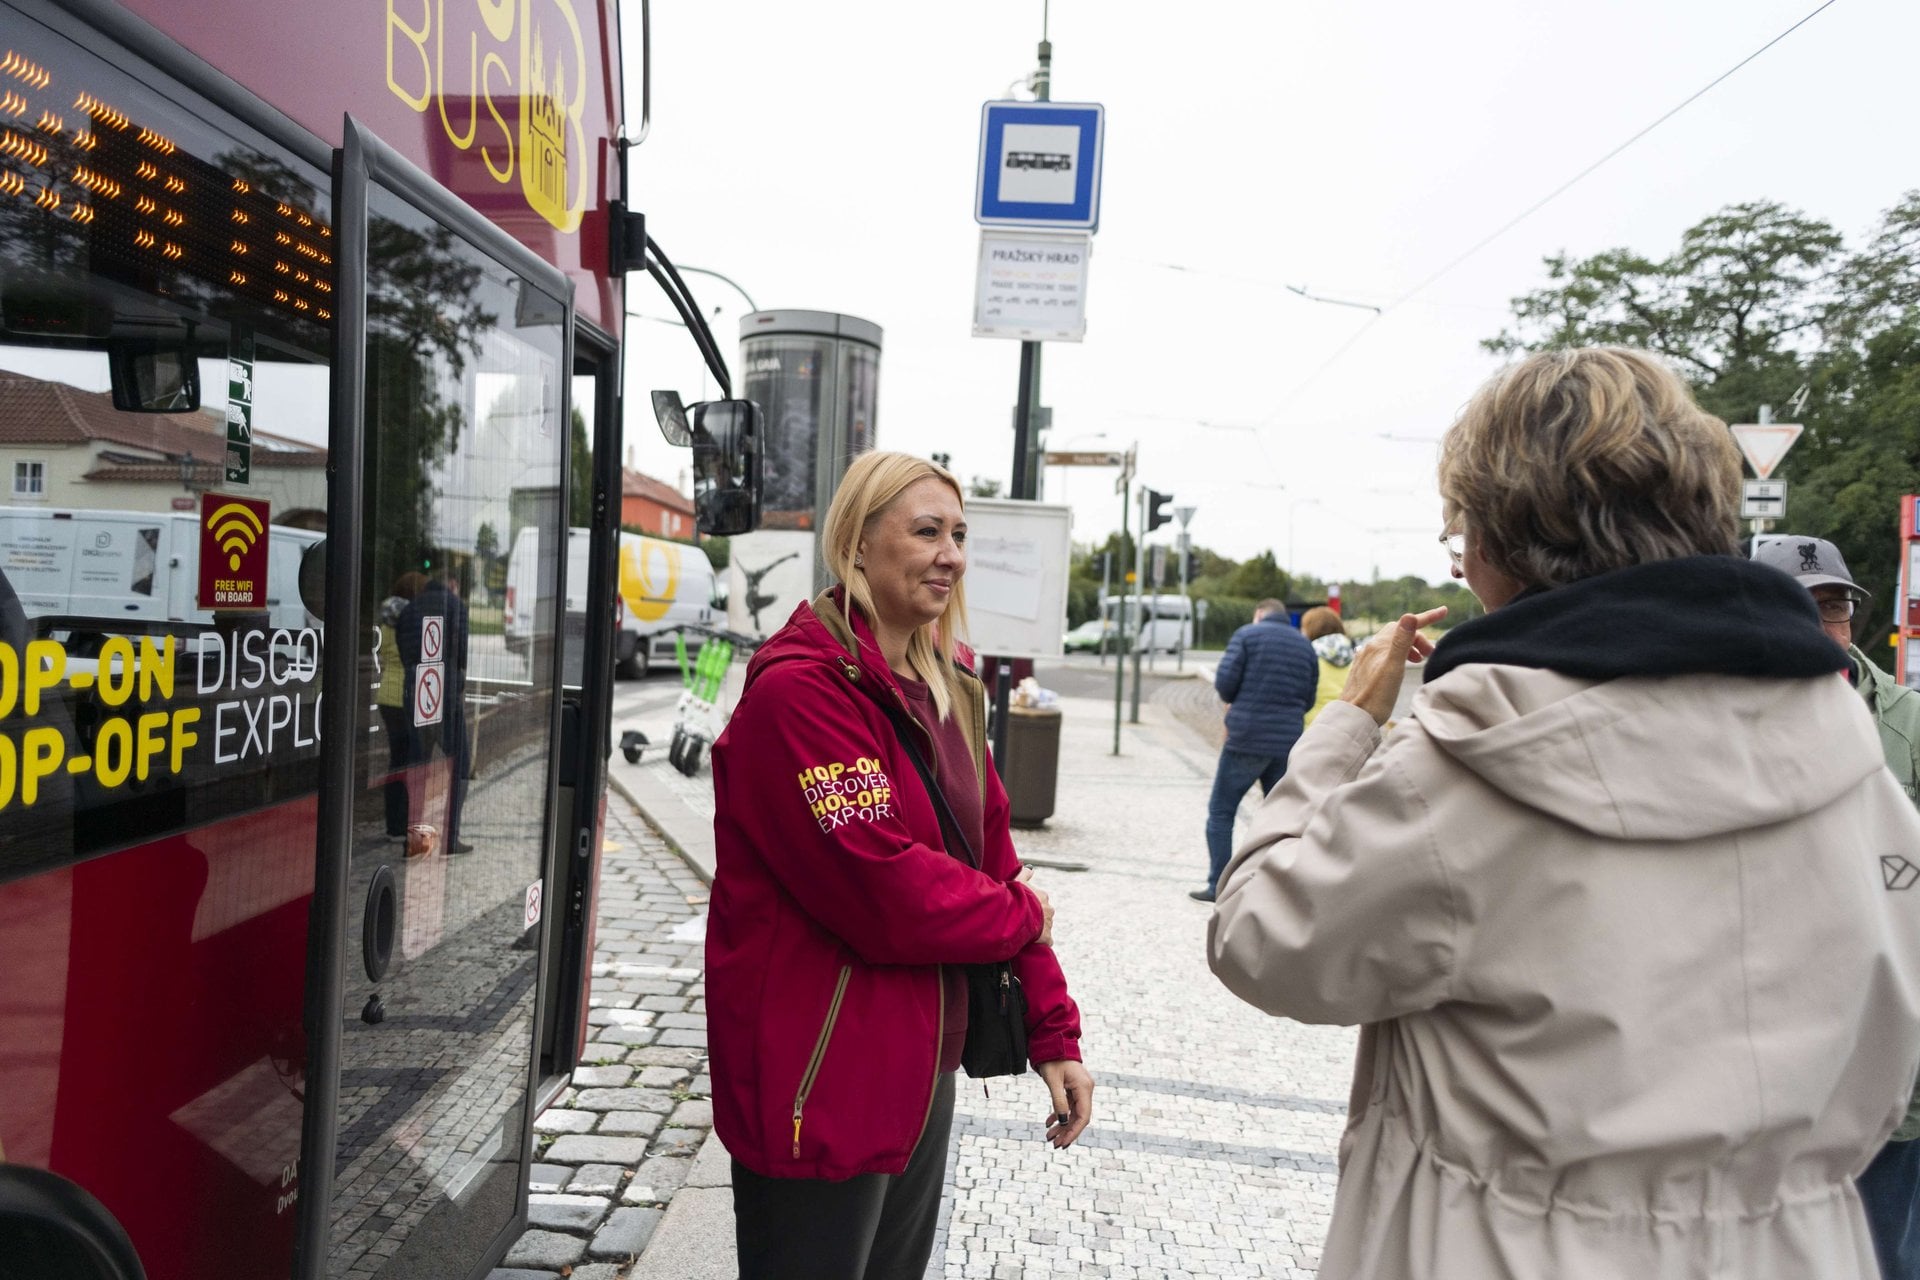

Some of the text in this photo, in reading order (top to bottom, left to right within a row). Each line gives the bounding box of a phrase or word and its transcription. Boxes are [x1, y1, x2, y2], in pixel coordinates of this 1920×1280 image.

[386, 0, 514, 184] BUS
[1047, 252, 1080, 265] HRAD
[214, 580, 253, 591] FREE WIFI
[215, 591, 253, 602] ON BOARD
[804, 773, 890, 804] DISCOVER
